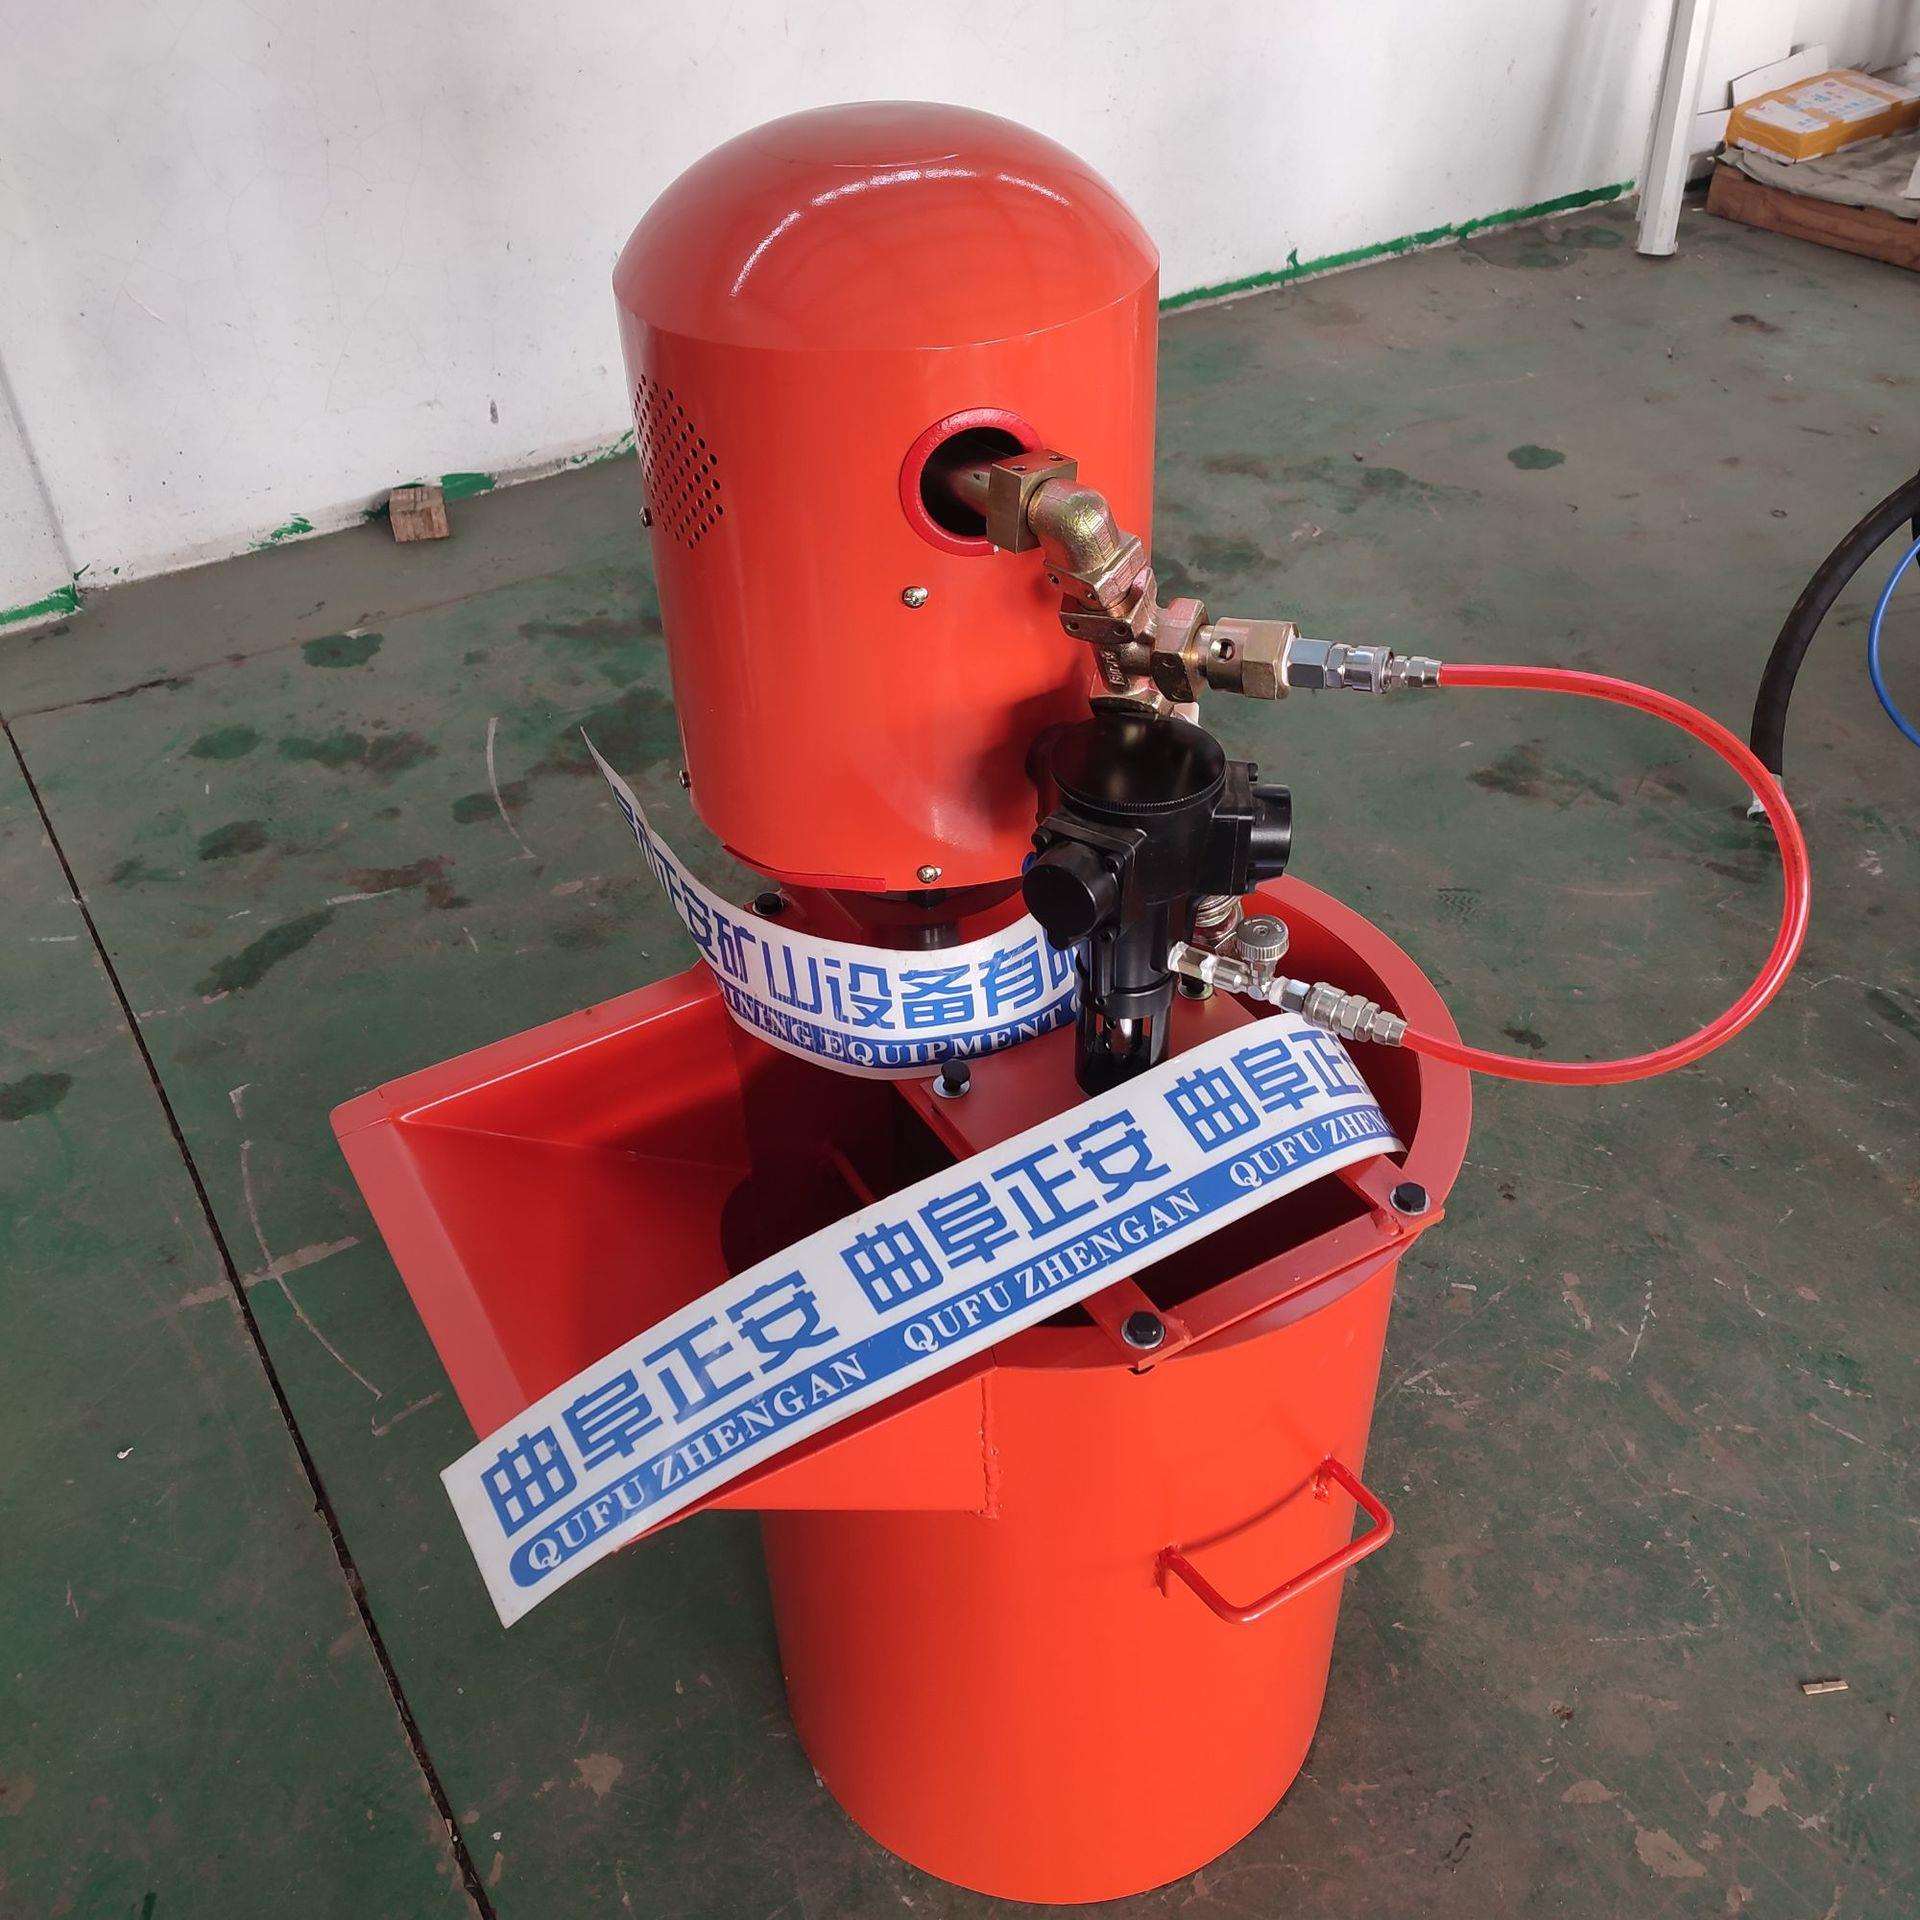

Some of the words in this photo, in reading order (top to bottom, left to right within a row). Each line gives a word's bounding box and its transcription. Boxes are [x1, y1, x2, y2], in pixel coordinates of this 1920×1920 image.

[823, 1003, 1062, 1066] EQUIPMENT
[480, 1270, 840, 1538] 曲阜正安
[839, 1109, 1171, 1315] 曲阜正安
[1163, 1030, 1370, 1153] 曲阜正
[528, 1477, 648, 1572] QUFU
[652, 1353, 867, 1489] ZHENGAN
[903, 1278, 1014, 1352] QUFU
[1015, 1189, 1200, 1299] ZHENGAN
[1229, 1127, 1322, 1189] QUFU
